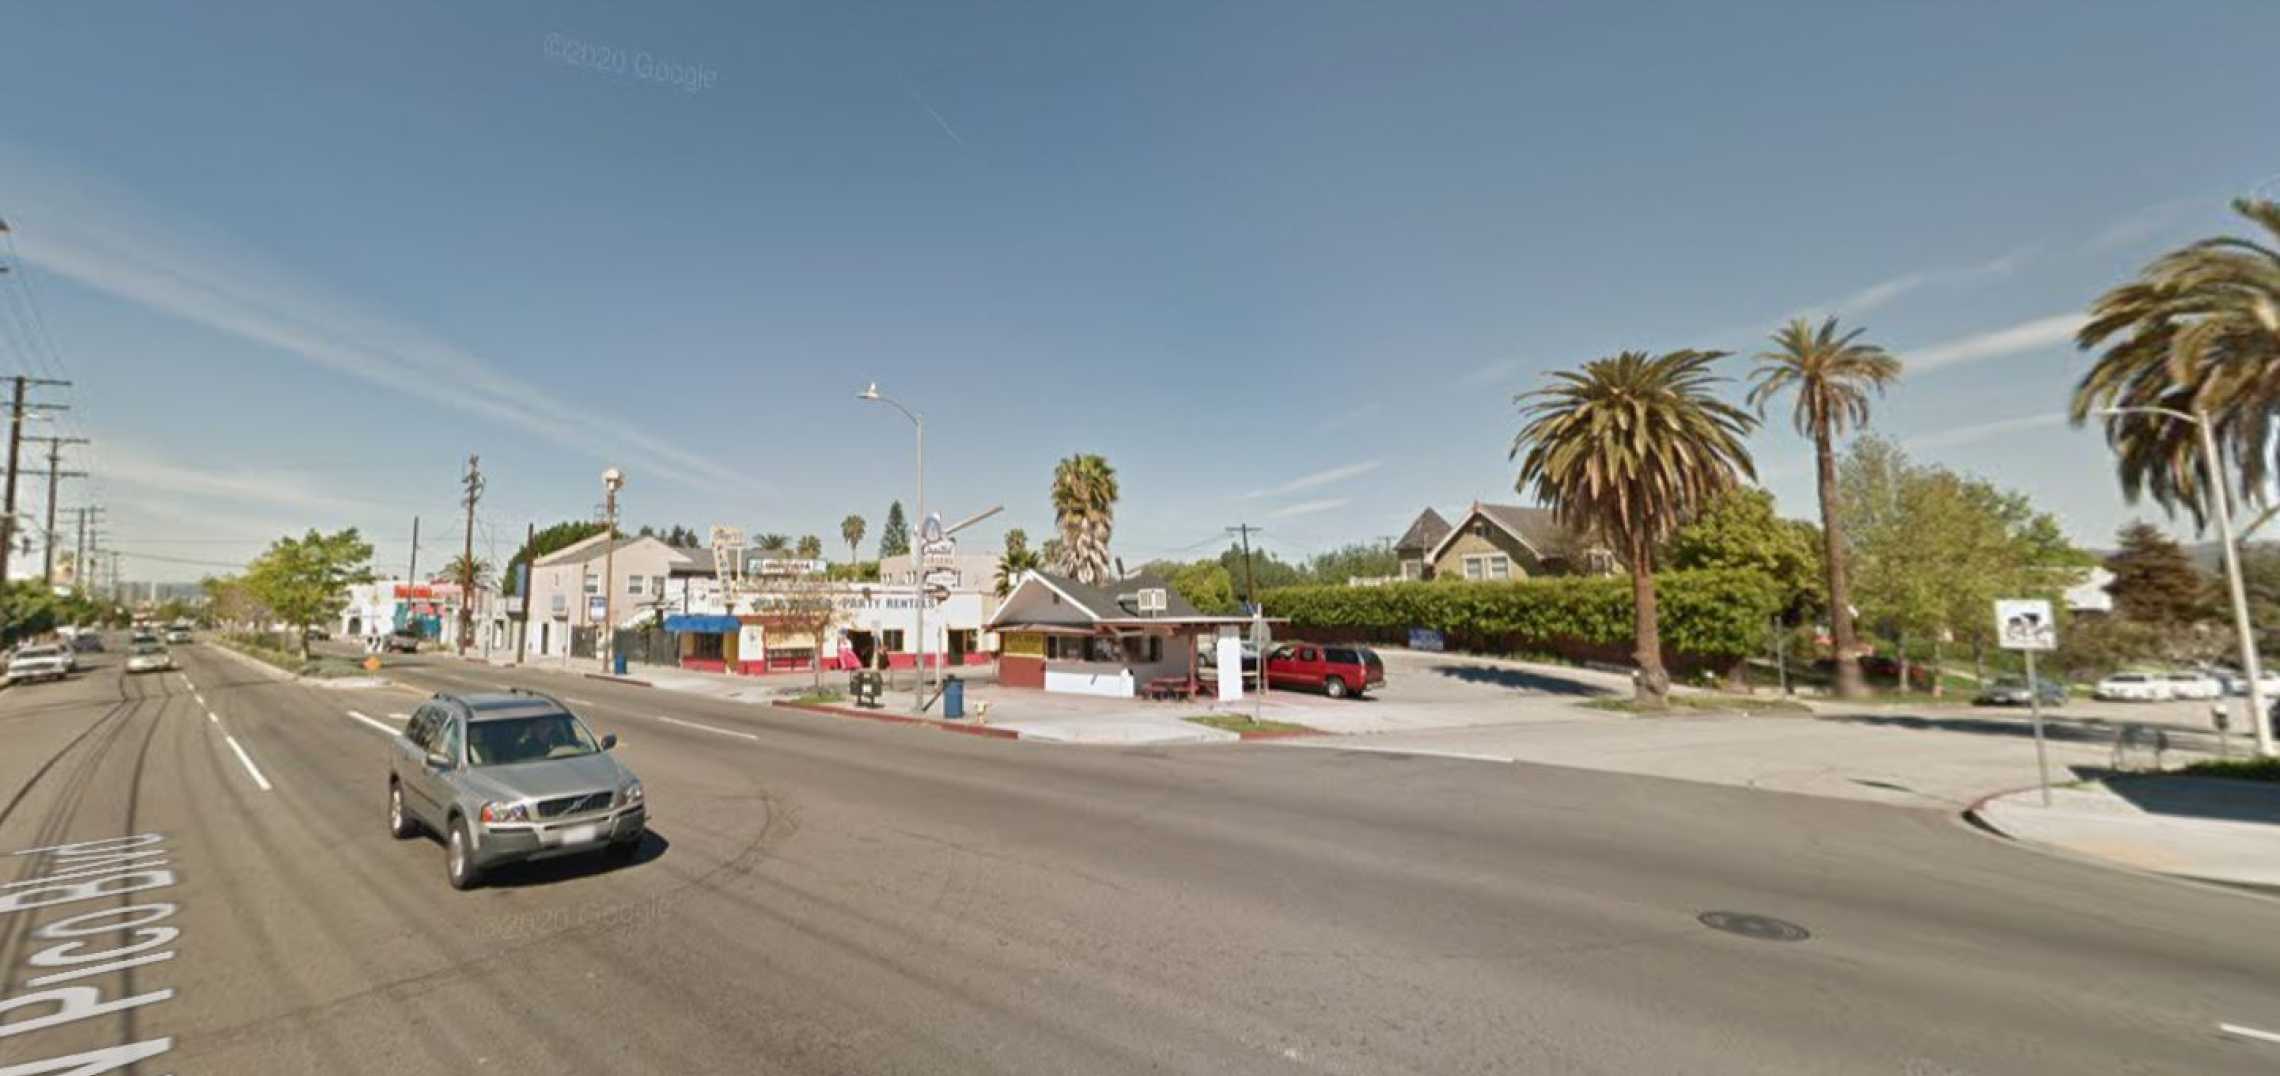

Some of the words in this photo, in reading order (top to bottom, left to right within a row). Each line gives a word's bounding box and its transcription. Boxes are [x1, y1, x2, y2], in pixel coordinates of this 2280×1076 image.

[842, 597, 880, 609] PARTY
[885, 597, 935, 609] RENTALS
[0, 833, 174, 912] Blvd
[0, 903, 178, 1036] Pico
